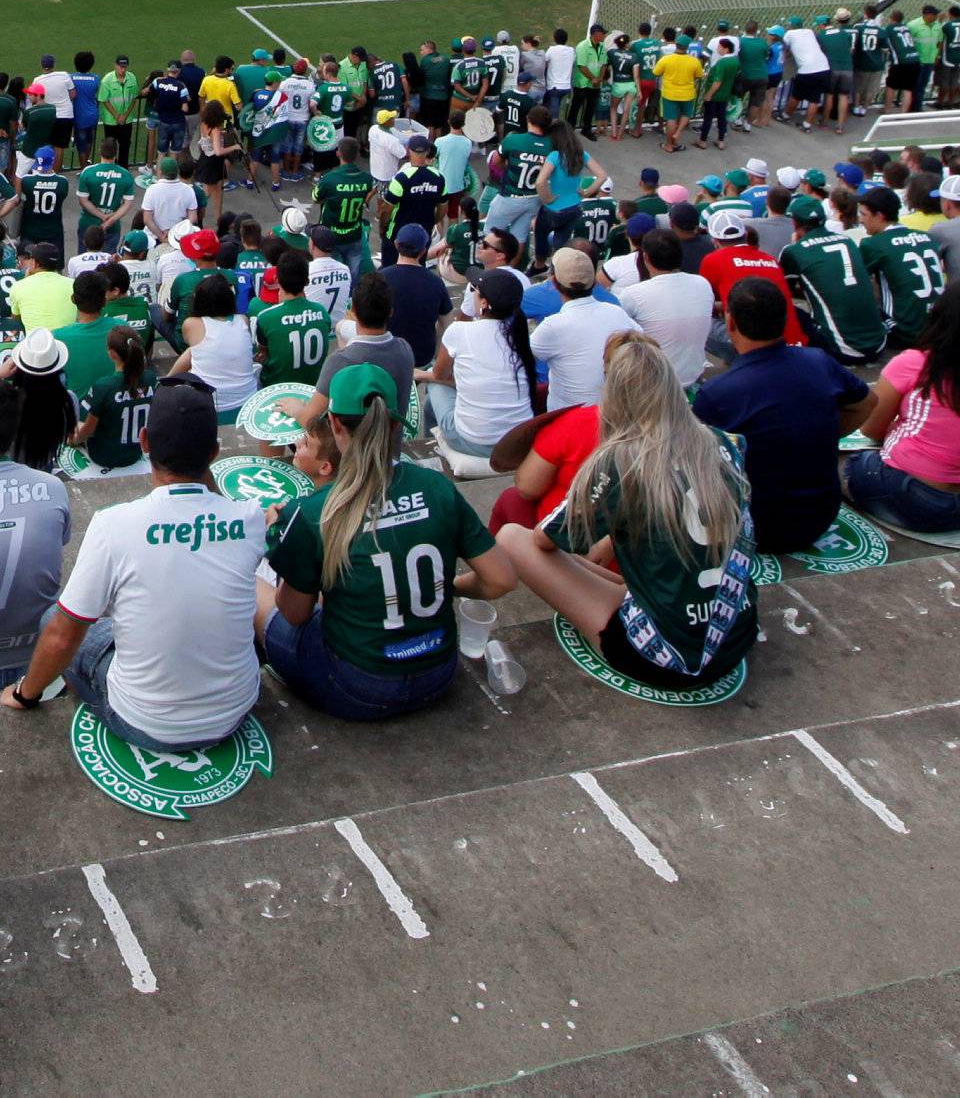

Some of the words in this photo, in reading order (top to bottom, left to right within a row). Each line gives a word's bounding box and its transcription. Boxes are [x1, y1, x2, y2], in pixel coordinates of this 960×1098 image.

[292, 94, 302, 110] 8
[330, 94, 342, 112] 9
[33, 190, 57, 215] 10
[100, 182, 116, 207] 11
[822, 242, 858, 286] 7
[902, 248, 946, 299] 33
[309, 271, 351, 288] crefisa
[280, 310, 324, 327] crefisa
[288, 327, 325, 370] 10
[145, 513, 246, 551] crefisa
[370, 543, 445, 630] 10
[598, 667, 625, 687] DE
[77, 733, 168, 812] ASSOCIAÇÃO
[193, 767, 223, 786] 1973
